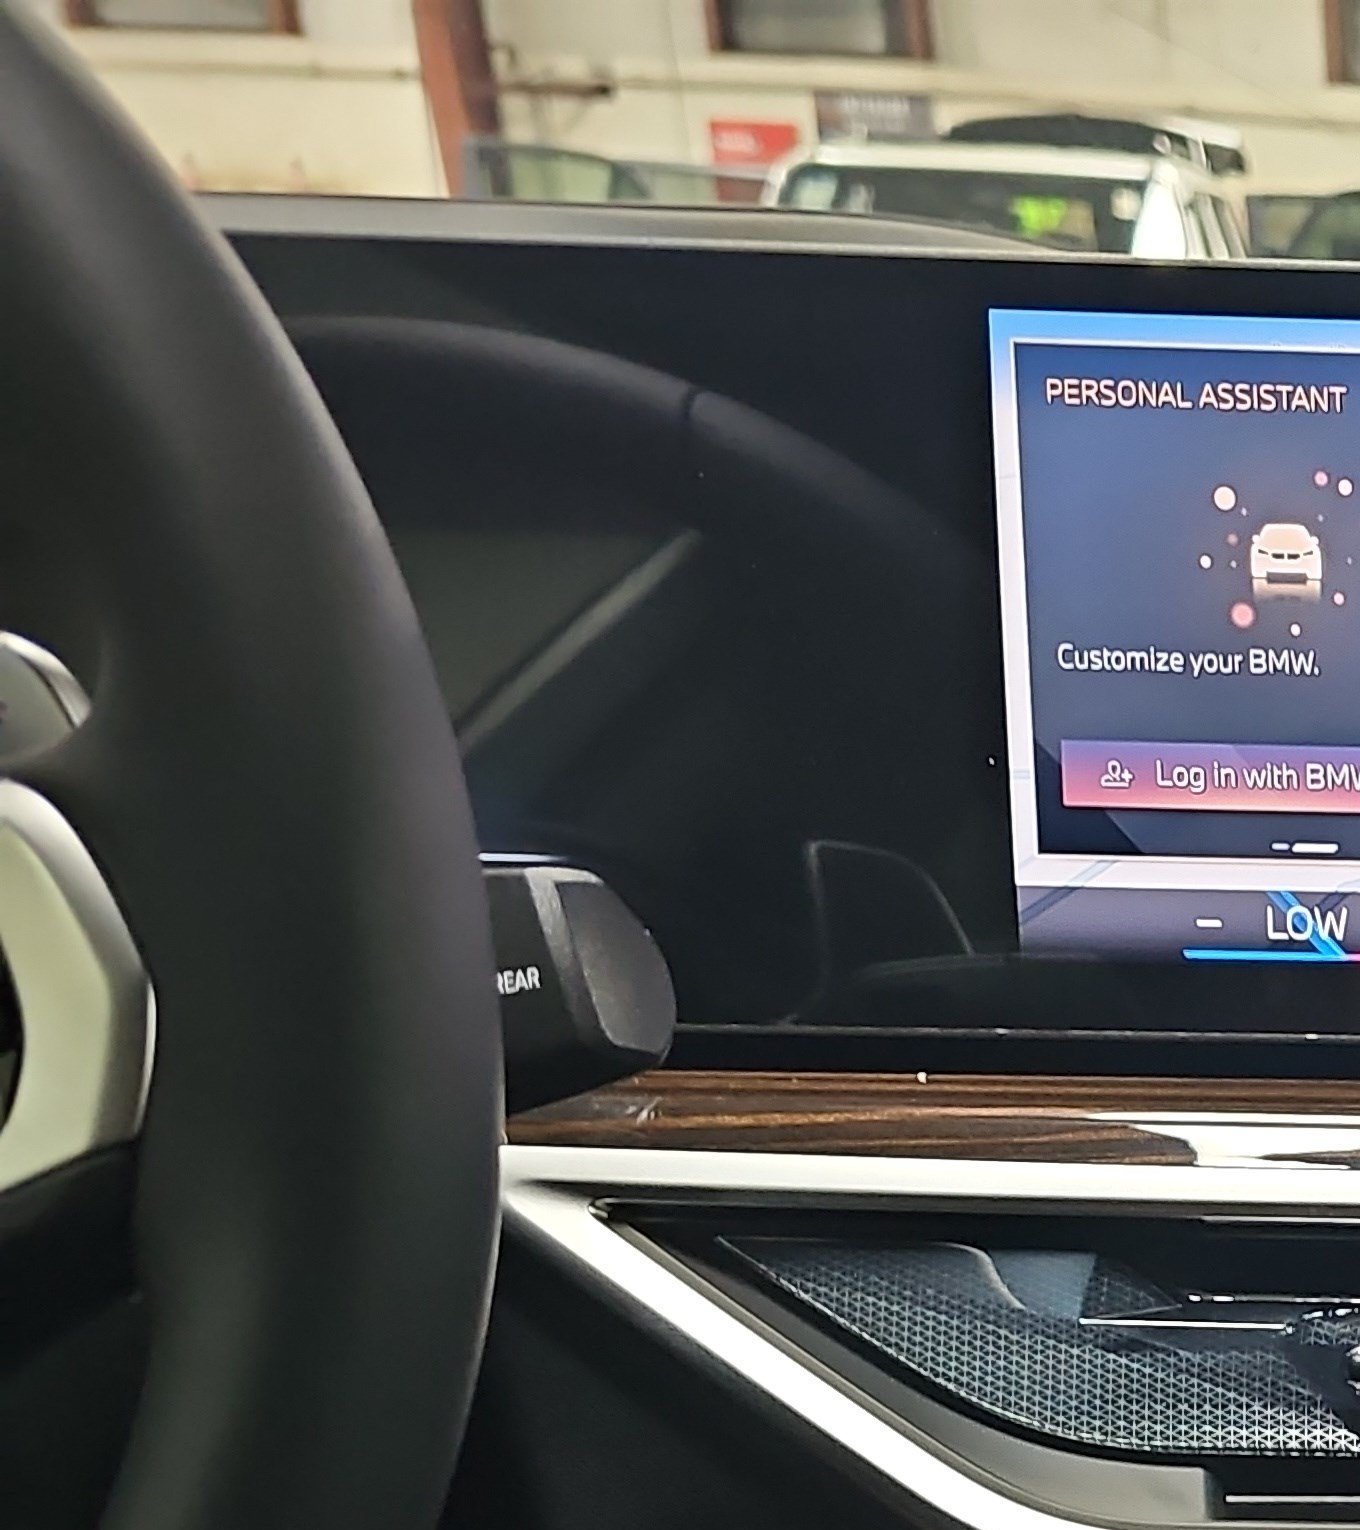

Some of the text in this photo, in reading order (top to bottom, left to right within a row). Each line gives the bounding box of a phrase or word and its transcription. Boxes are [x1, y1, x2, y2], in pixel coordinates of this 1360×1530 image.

[1045, 378, 1347, 414] PERSONAL ASSISTANT
[1057, 642, 1320, 677] Customize your BMW.
[1156, 759, 1205, 795] Log
[1213, 763, 1237, 789] in
[1243, 763, 1299, 790] with
[1266, 906, 1347, 942] LOW
